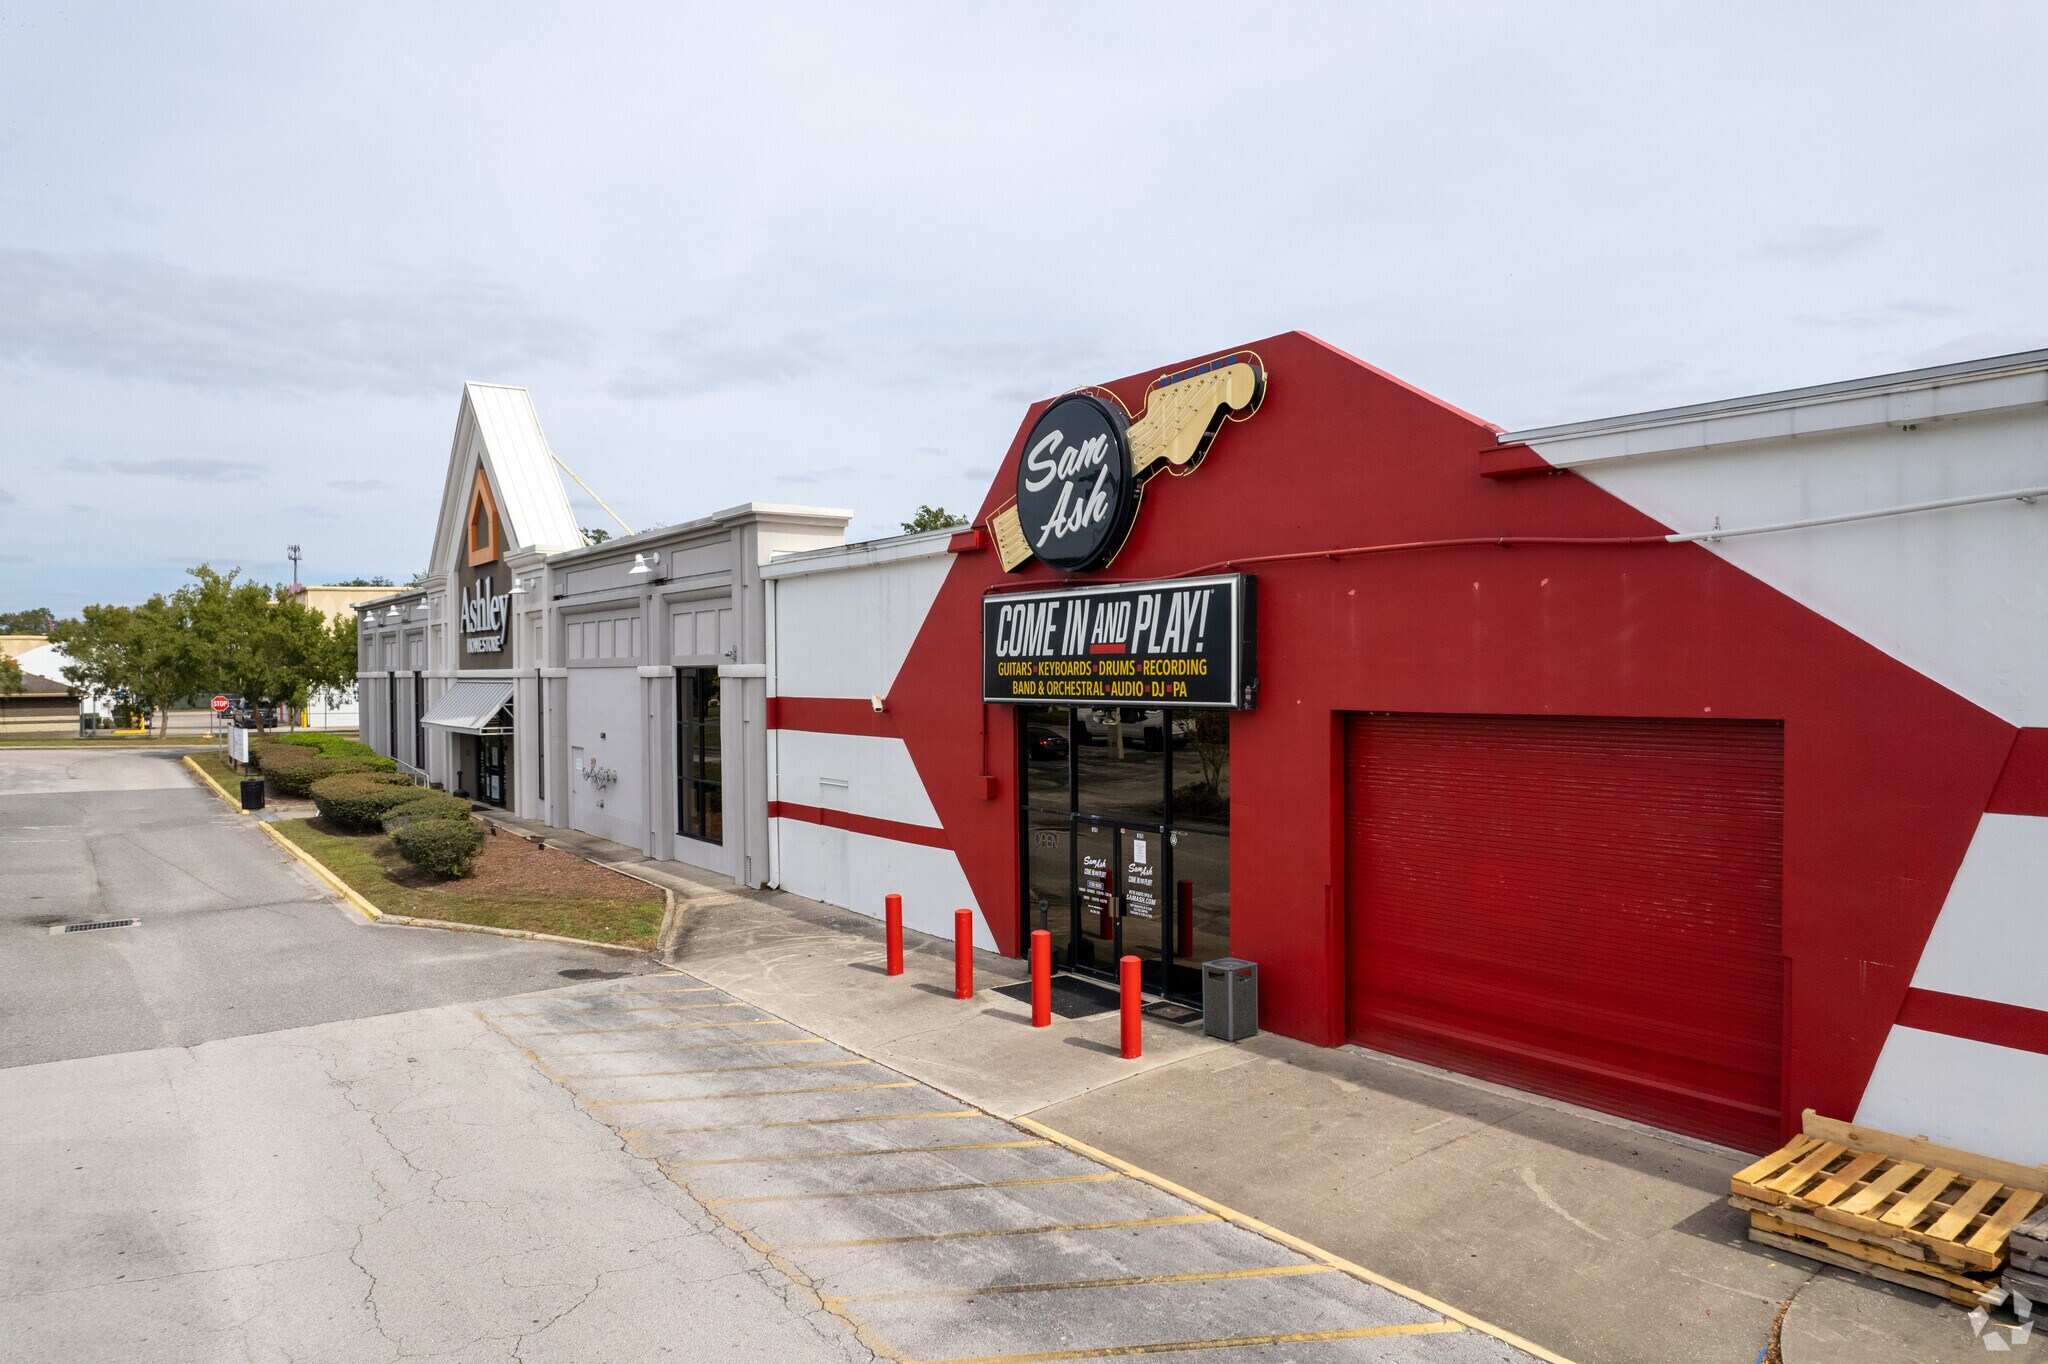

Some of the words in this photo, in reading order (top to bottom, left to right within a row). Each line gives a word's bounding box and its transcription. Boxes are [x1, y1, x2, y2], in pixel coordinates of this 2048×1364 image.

[1025, 429, 1108, 492] Sam
[1036, 463, 1109, 548] Ash
[460, 576, 509, 645] Ashley
[996, 601, 1060, 657] COME
[1061, 599, 1090, 656] IN
[1090, 601, 1131, 644] AND
[1131, 589, 1211, 654] PLAY!
[466, 635, 501, 654] HOMESTORE
[998, 661, 1033, 677] GUITARS
[1038, 660, 1092, 676] KEYBOARDS
[1099, 659, 1136, 676] DRUMS
[1143, 658, 1208, 676] RECORDING
[1012, 681, 1036, 696] BAND
[1037, 682, 1045, 695] &
[1046, 680, 1105, 697] ORCHESTRAL
[1111, 681, 1144, 697] AUDIO
[1151, 681, 1165, 697] DJ
[1173, 681, 1188, 698] PA
[1034, 832, 1059, 849] OPEN
